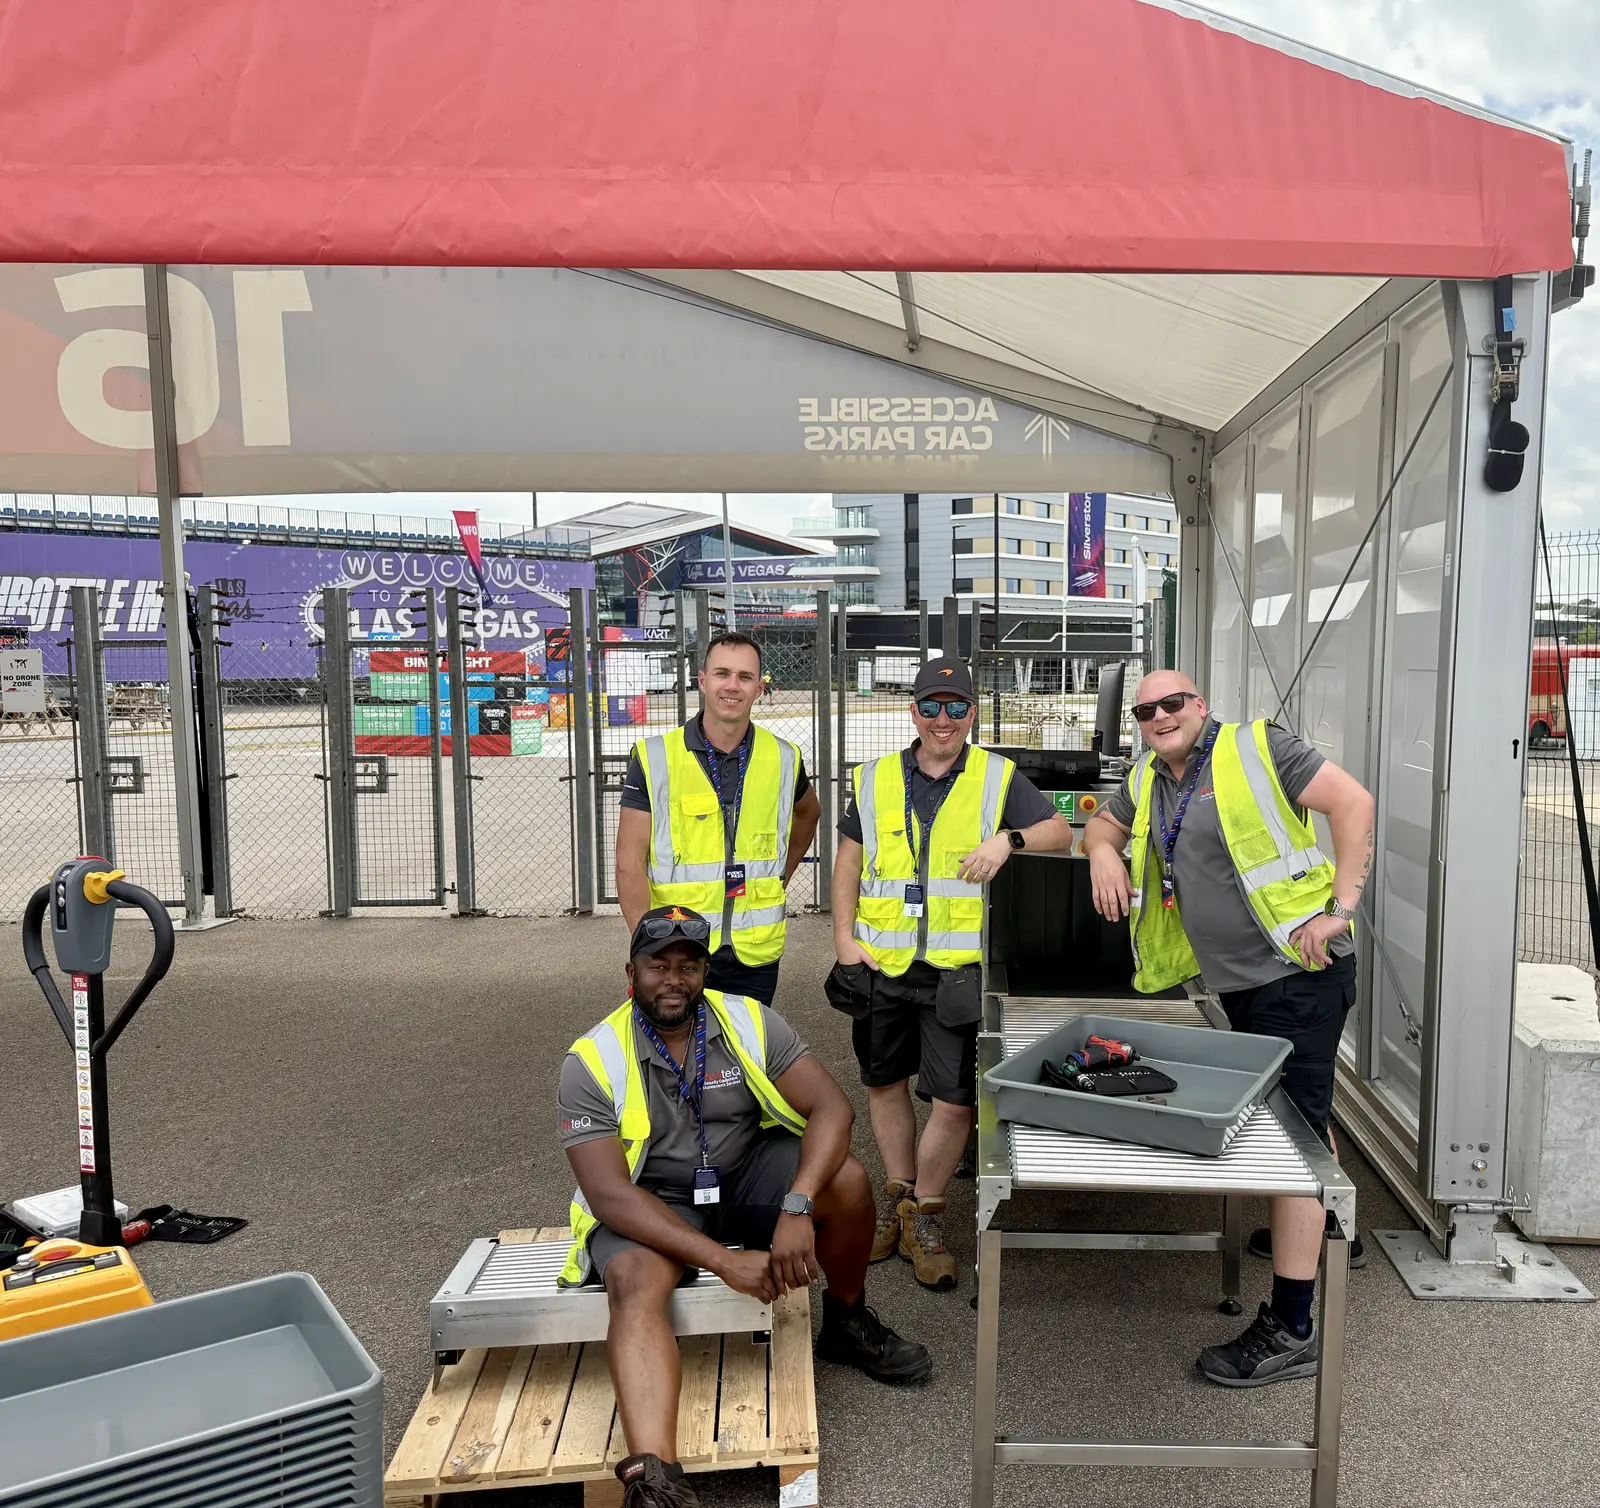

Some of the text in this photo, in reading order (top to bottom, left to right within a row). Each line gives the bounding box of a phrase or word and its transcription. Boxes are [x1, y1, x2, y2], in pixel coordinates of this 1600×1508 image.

[738, 564, 785, 577] VEGAS
[371, 590, 390, 602] TO
[351, 607, 417, 639] LAS
[644, 629, 670, 639] KART
[403, 657, 429, 668] BIN
